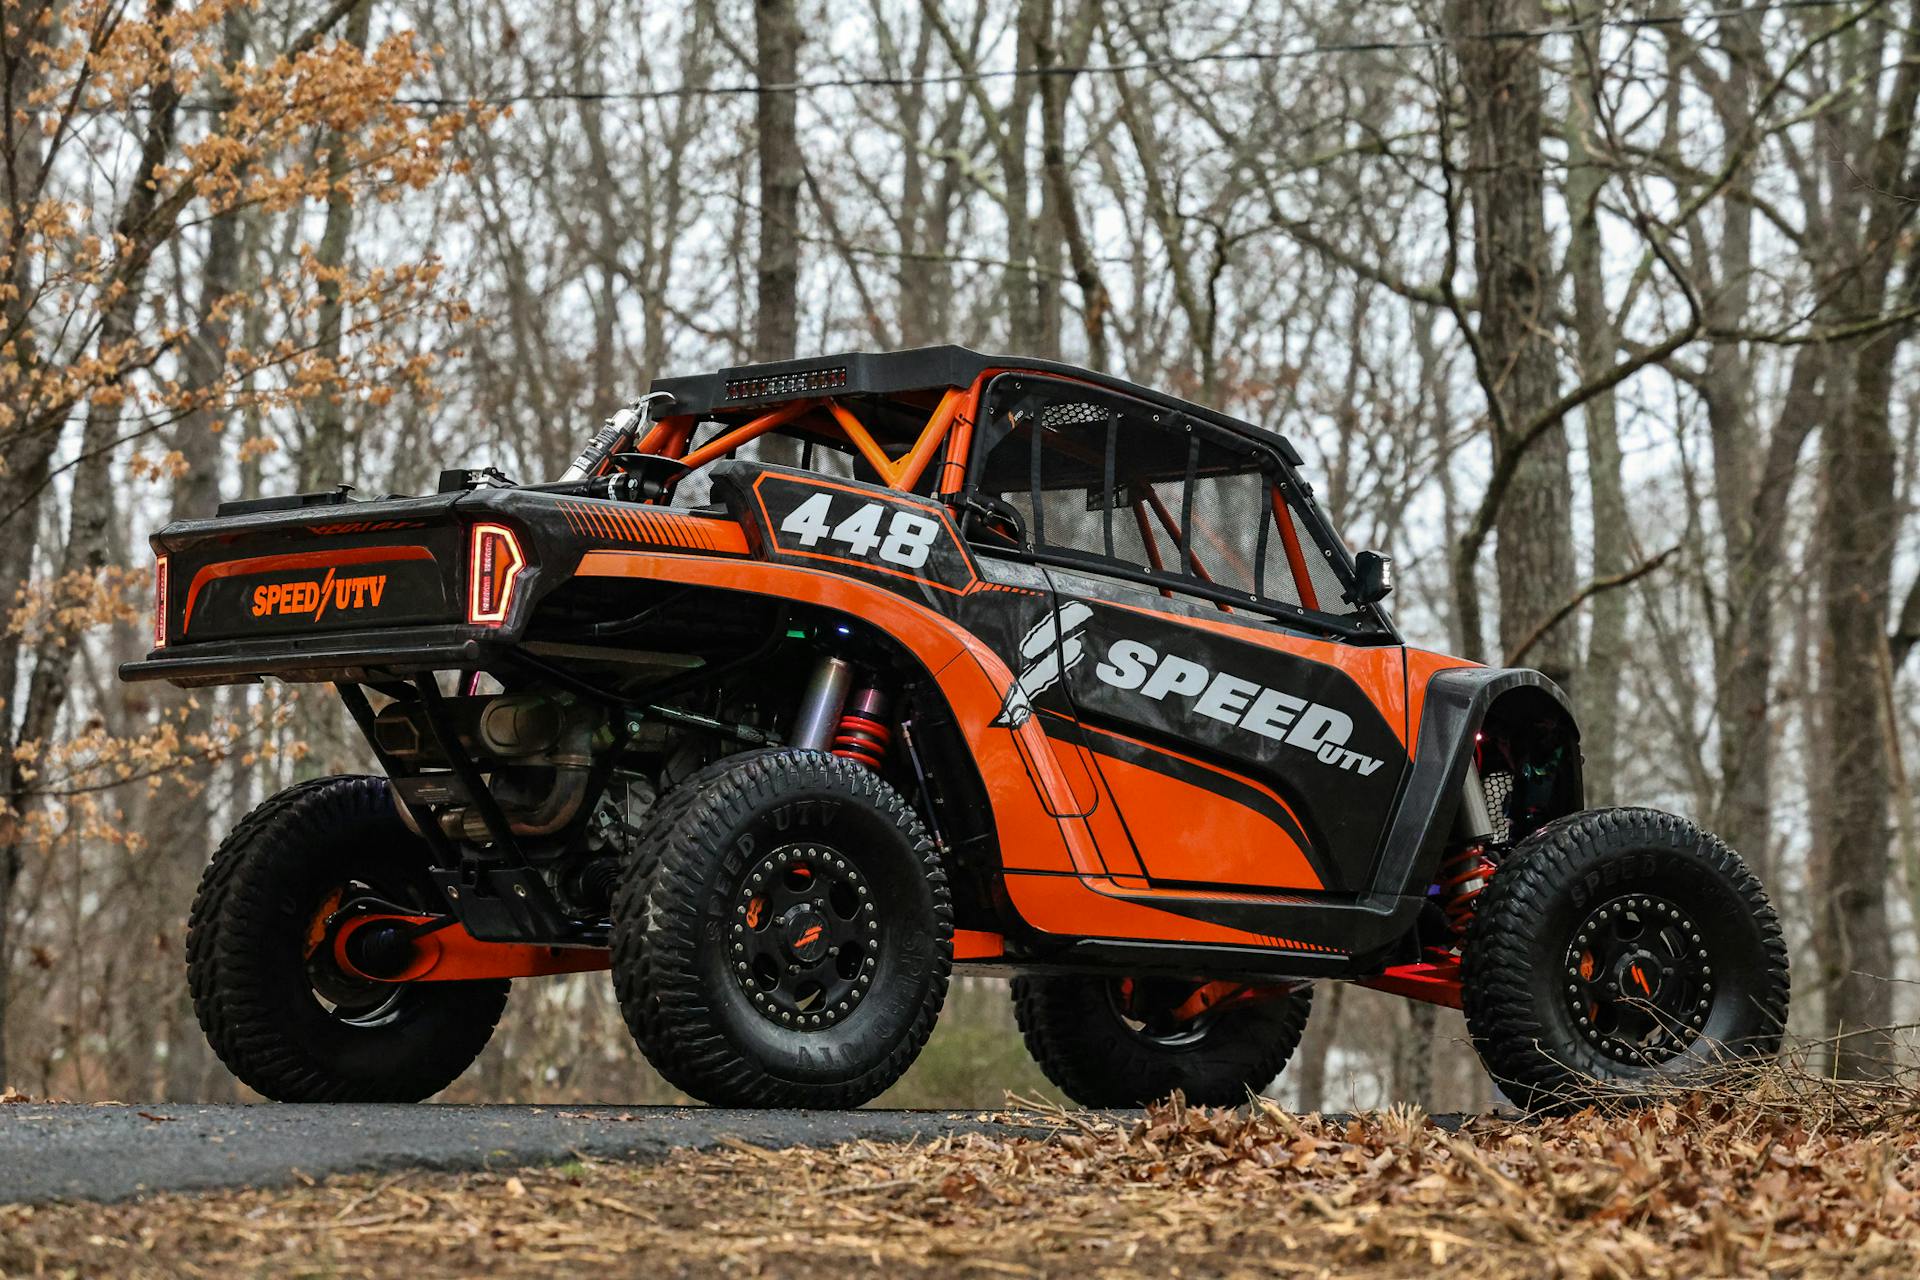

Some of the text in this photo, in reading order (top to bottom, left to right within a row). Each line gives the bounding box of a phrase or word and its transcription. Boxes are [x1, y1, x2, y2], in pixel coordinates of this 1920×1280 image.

[780, 492, 940, 569] 448
[1095, 639, 1385, 777] SPEED UTV
[703, 800, 842, 943] SPEED UTV
[1569, 853, 1658, 910] SPEED
